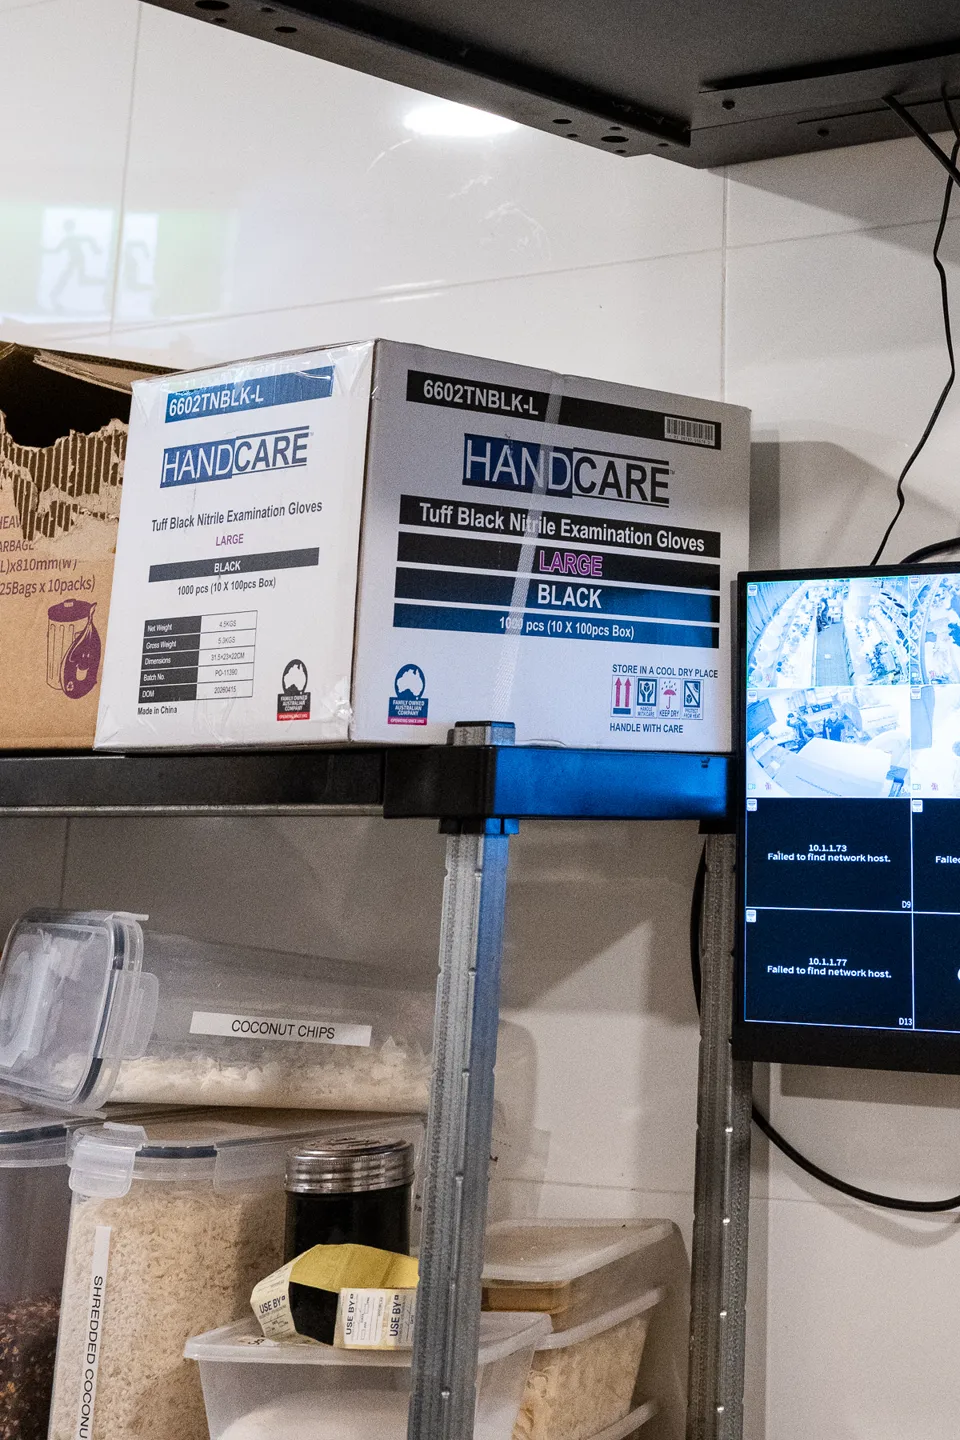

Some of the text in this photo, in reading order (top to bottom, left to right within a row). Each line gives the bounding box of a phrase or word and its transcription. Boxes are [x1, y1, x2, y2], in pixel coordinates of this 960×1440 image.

[169, 385, 264, 417] 6602TNBLK-L
[424, 379, 539, 415] 6602TNBLK-L
[162, 432, 309, 483] HANDCARE
[465, 439, 670, 503] HANDCARE
[152, 499, 323, 532] Tuff Black Nitrile Examination Gloves
[419, 502, 705, 552] Tuff Black Nitrile Examination Gloves
[215, 533, 244, 546] LARGE
[214, 561, 241, 573] BLACK
[539, 550, 603, 576] LARGE
[48, 574, 95, 595] 10packs)
[178, 585, 194, 596] 1000
[196, 584, 209, 596] pcs
[210, 582, 222, 594] (10
[231, 580, 256, 593] 100pcs
[259, 577, 276, 589] Box)
[538, 584, 602, 609] BLACK
[156, 623, 173, 633] Weight
[526, 621, 544, 633] pcs
[547, 620, 563, 635] (10
[565, 621, 573, 633] X
[575, 622, 610, 638] 100pcs
[612, 625, 634, 640] Box)
[146, 640, 177, 650] Gross Weight
[144, 656, 171, 665] Dimensions
[143, 673, 157, 682] Batch
[612, 664, 718, 678] STORE IN A COOL DRY PLACE
[142, 690, 155, 698] DOM
[137, 705, 177, 715] Made in China
[610, 723, 683, 733] HANDLE WITH CARE
[808, 844, 847, 852] 10.1.1.73
[767, 852, 891, 862] Failed to find network host.
[901, 900, 911, 908] D9
[808, 958, 848, 966] 10.1.1.77
[766, 965, 892, 978] Failed to find network host.
[898, 1017, 913, 1026] D13
[231, 1019, 335, 1040] COCONUT CHIPS
[259, 1301, 272, 1314] USE
[272, 1297, 282, 1308] BY
[86, 1275, 103, 1365] SHREDDED
[345, 1300, 355, 1335] USE BY
[389, 1302, 401, 1337] USE BY
